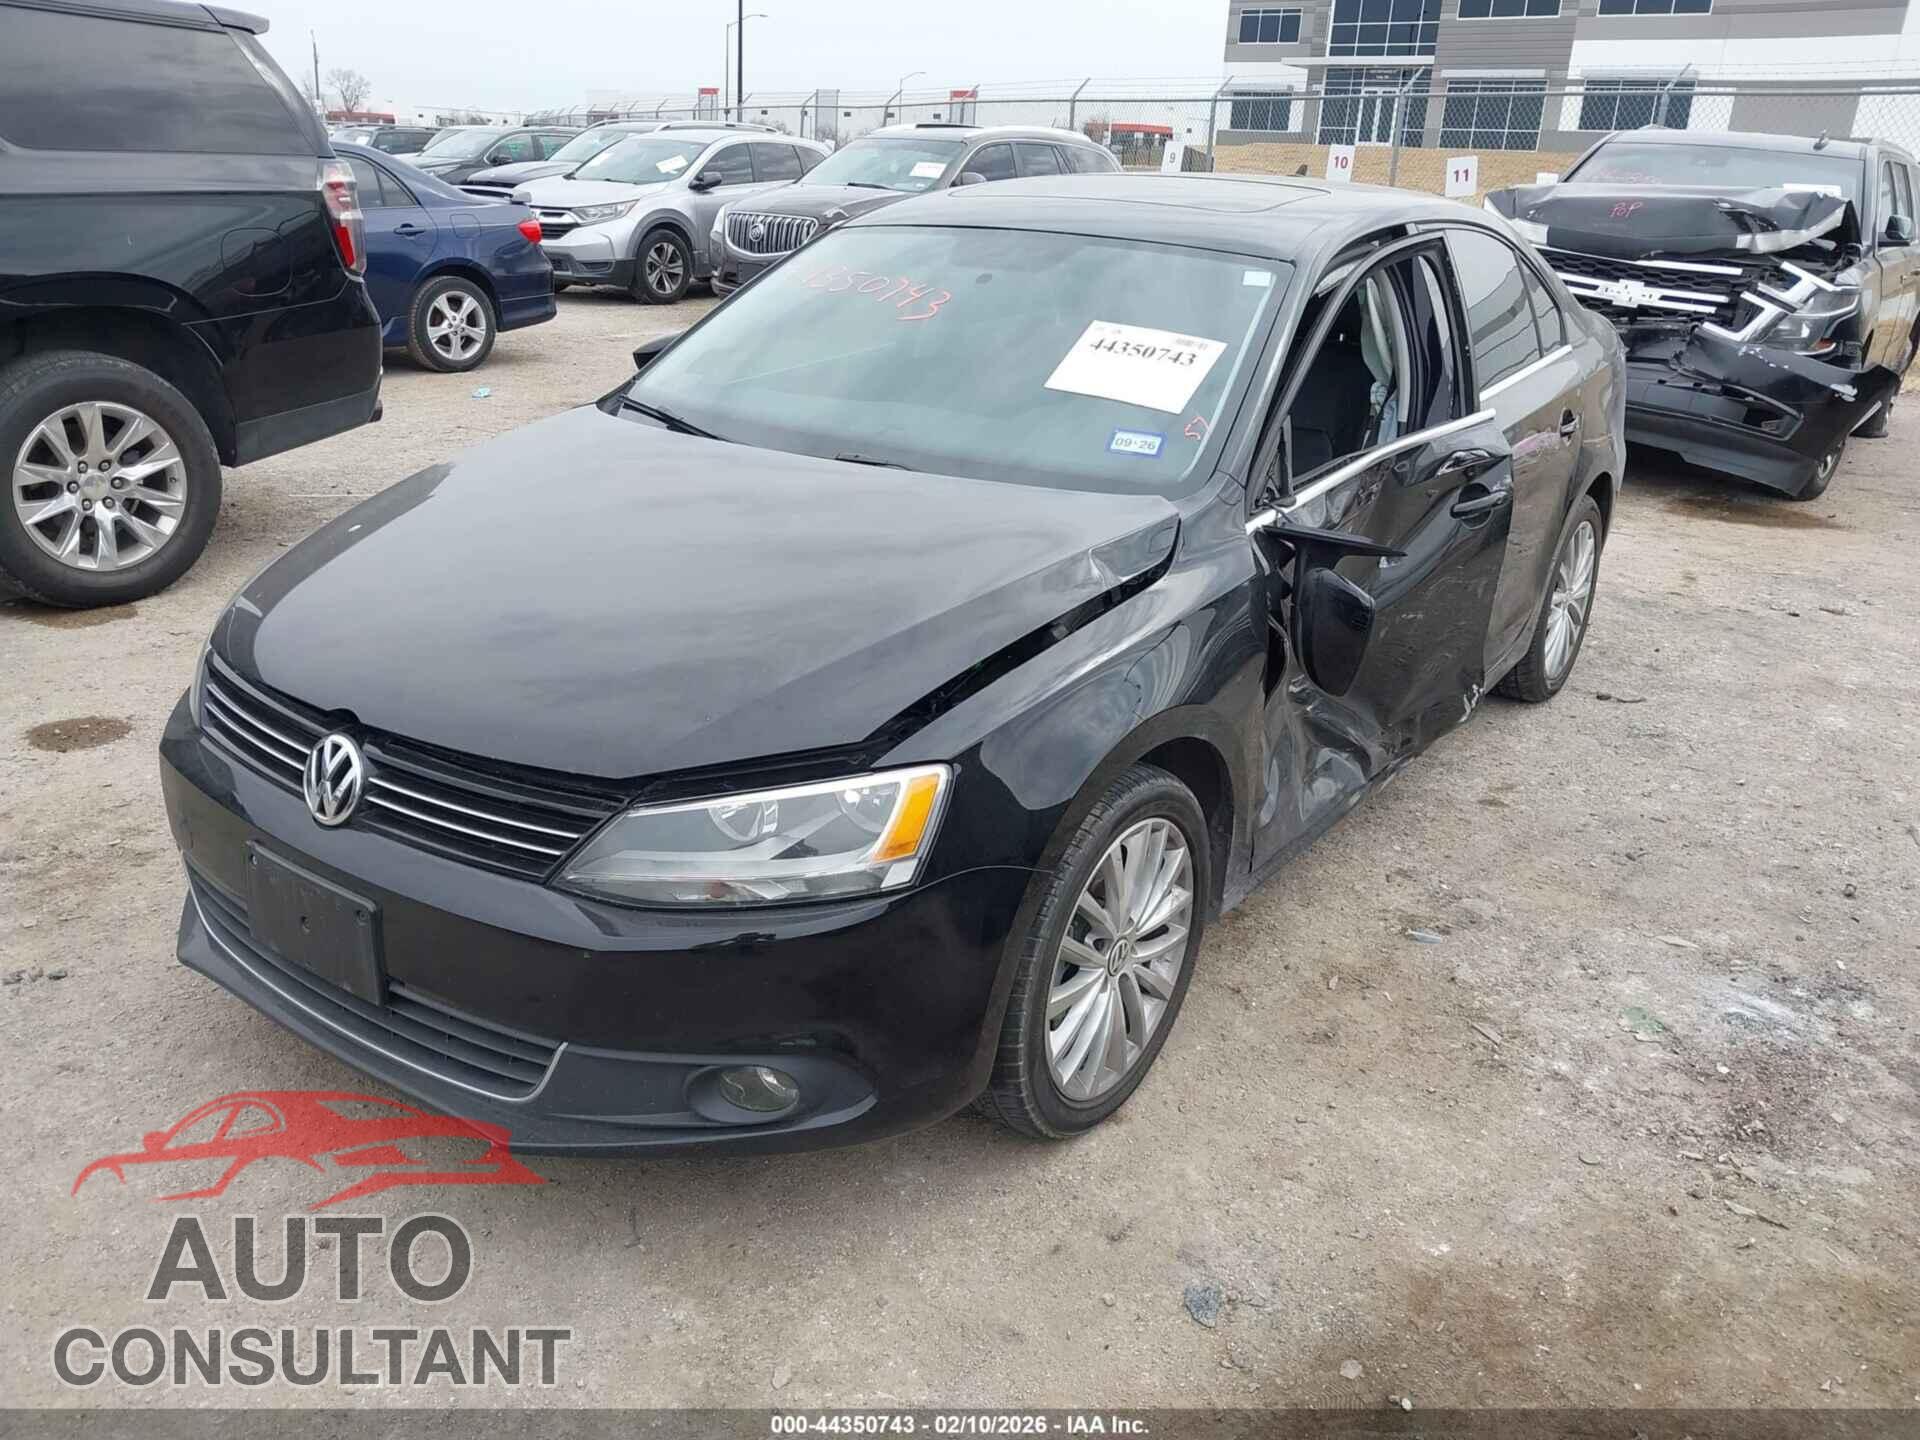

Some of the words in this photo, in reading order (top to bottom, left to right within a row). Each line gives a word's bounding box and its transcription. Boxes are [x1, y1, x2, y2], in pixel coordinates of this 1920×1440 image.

[1169, 152, 1176, 164] 9
[1333, 156, 1348, 169] 10
[1453, 168, 1469, 182] 11
[1090, 338, 1197, 367] 44350743
